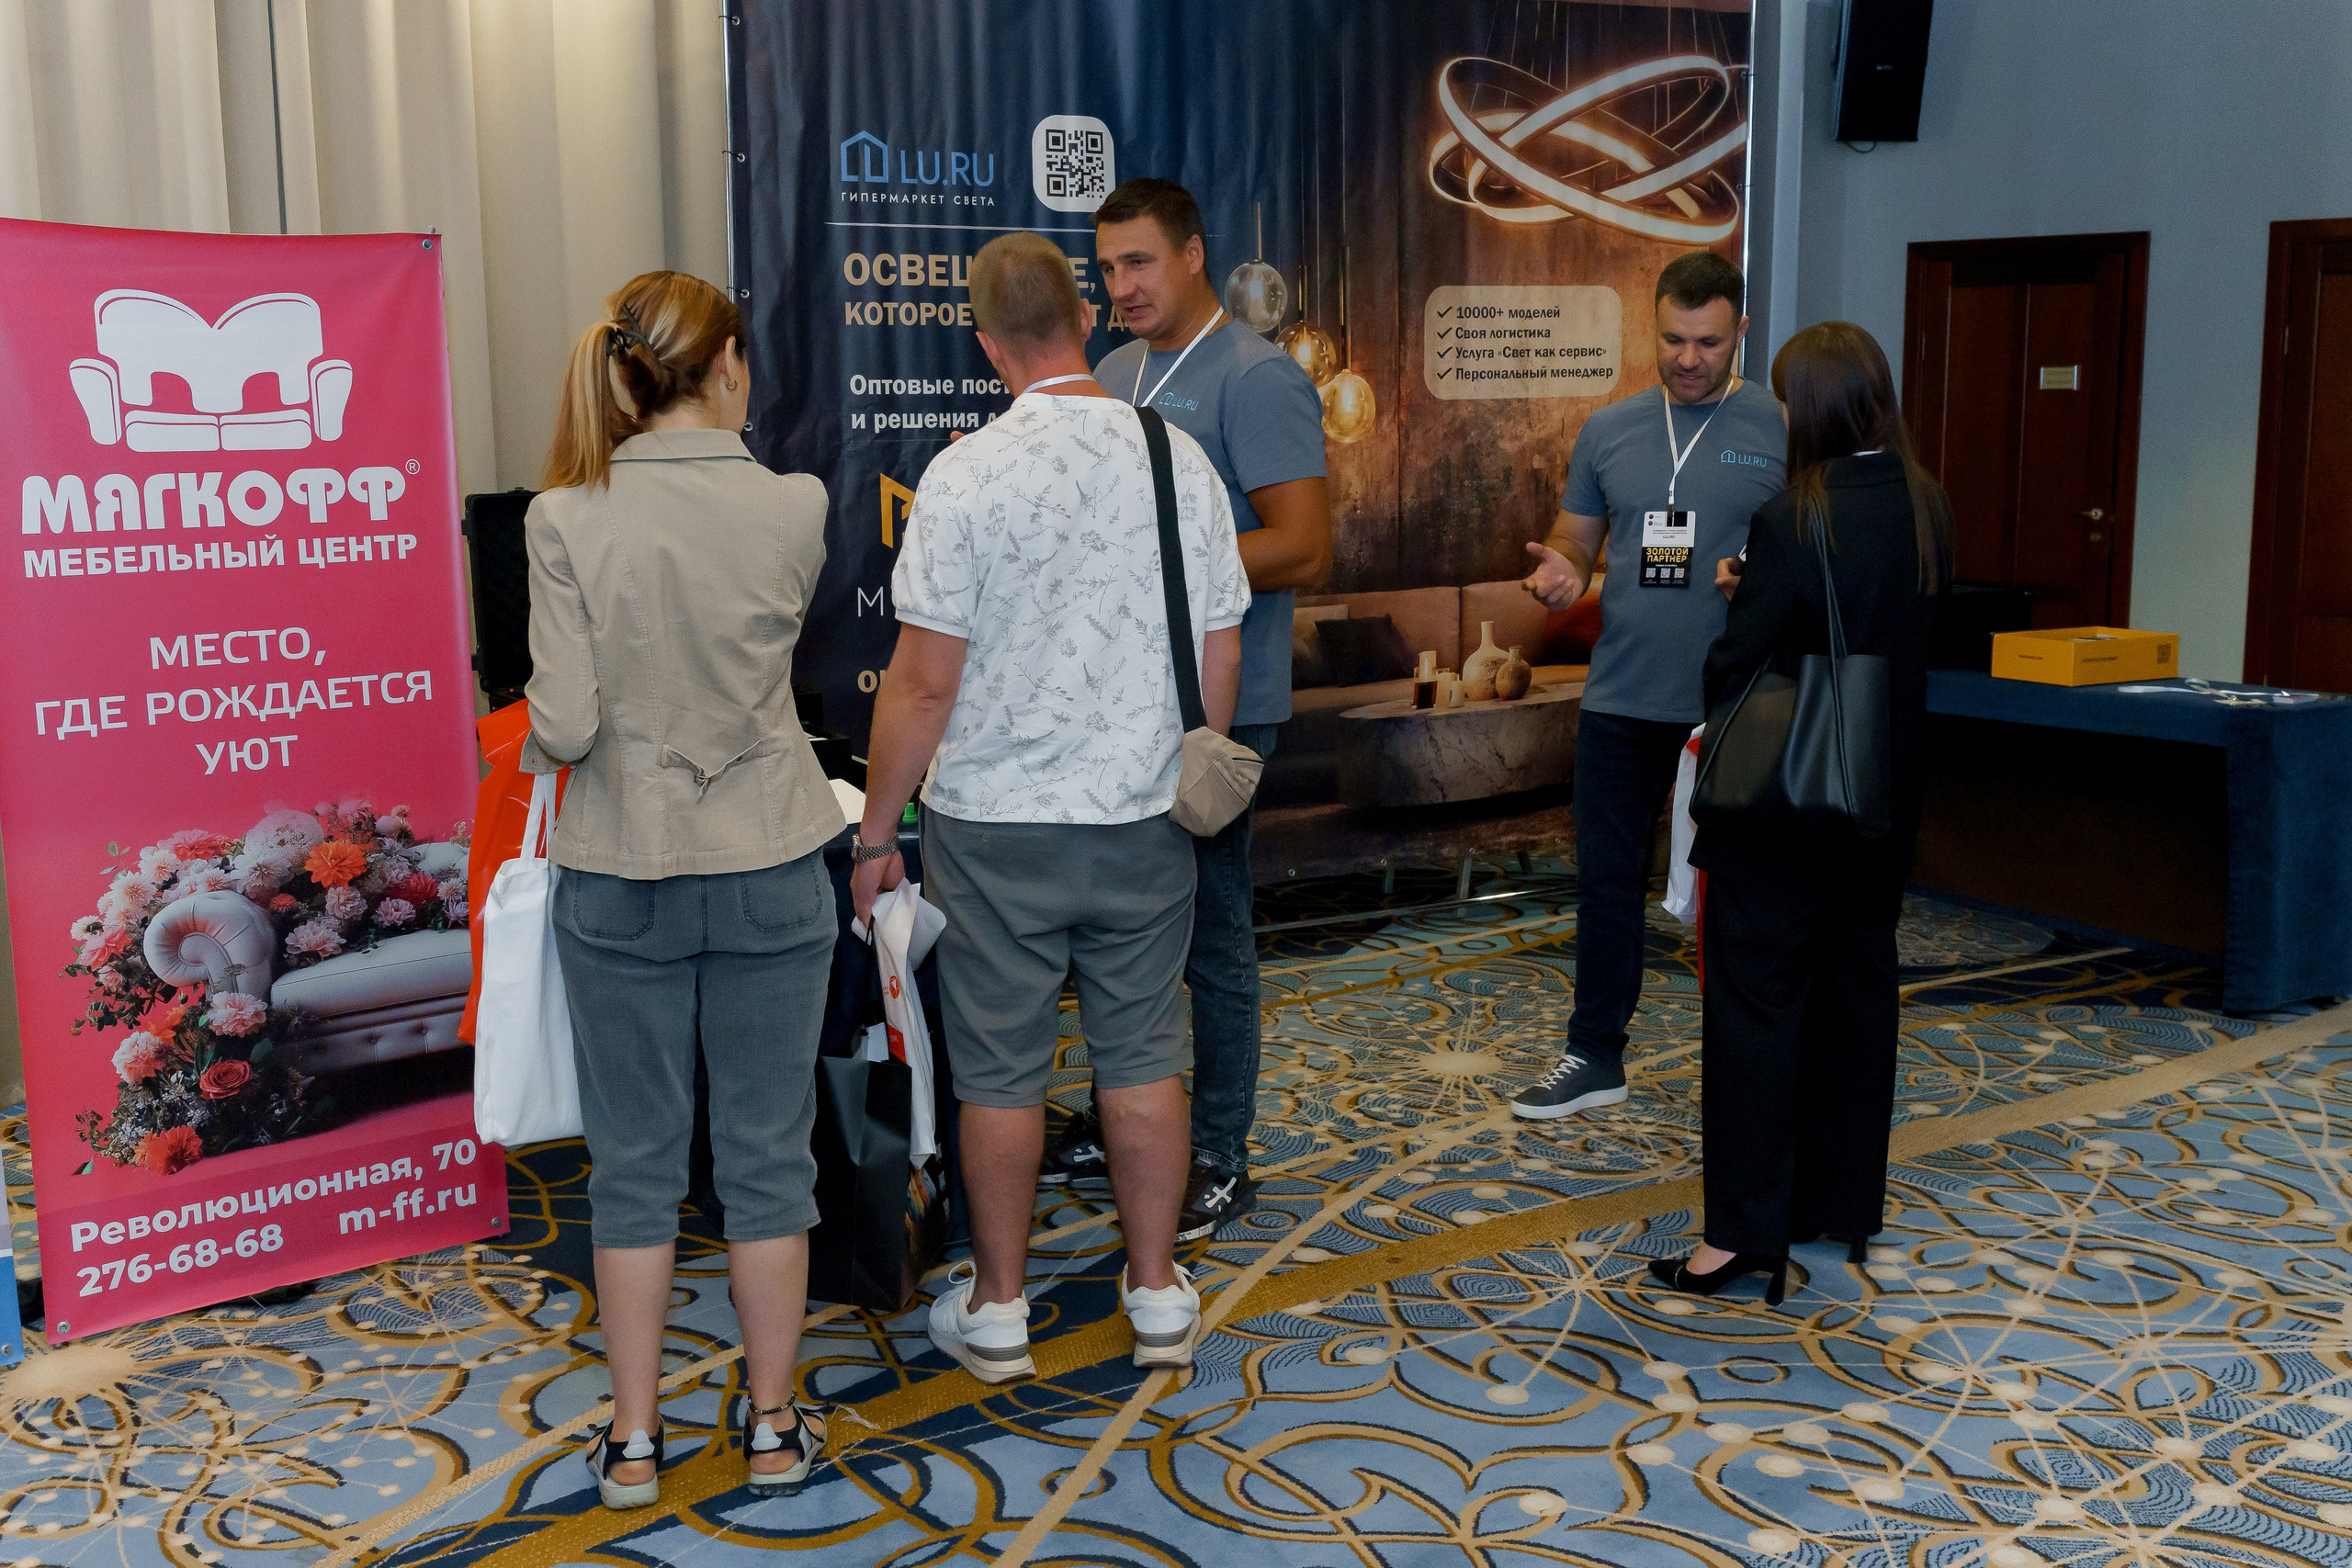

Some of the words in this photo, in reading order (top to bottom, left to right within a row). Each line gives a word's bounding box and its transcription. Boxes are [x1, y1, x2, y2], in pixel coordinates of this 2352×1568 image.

[900, 150, 994, 186] LU.RU
[841, 192, 944, 205] ГИПЕРМАРКЕТ
[953, 195, 995, 206] СВЕТА
[844, 301, 973, 326] КОТОРОЕ
[1456, 306, 1504, 319] 10000+
[1509, 306, 1560, 320] моделей
[1455, 327, 1487, 339] Своя
[1489, 328, 1551, 339] логистика
[1455, 346, 1494, 361] Услуга
[1535, 348, 1555, 357] как
[1456, 366, 1547, 382] Персональный
[1551, 367, 1613, 379] менеджер
[850, 375, 955, 395] Оптовые
[1172, 397, 1199, 411] LU.RU
[852, 413, 865, 429] и
[875, 412, 979, 433] решения
[1738, 454, 1768, 468] LU.RU
[22, 467, 406, 535] МЯГКОФФ
[24, 534, 285, 578] МЕБЕЛЬНЫЙ
[299, 534, 418, 570] ЦЕНТР
[1645, 547, 1689, 556] ЗОЛОТОЙ
[1646, 555, 1688, 563] ПАРТНЕР
[150, 626, 327, 670] МЕСТО,
[35, 695, 128, 740] ГДЕ
[146, 670, 433, 726] РОЖДАЕТСЯ
[195, 735, 299, 775] УЮТ
[70, 1157, 424, 1252] Революционная,
[432, 1138, 477, 1172] 70
[338, 1180, 478, 1235] m-ff.ru
[75, 1224, 284, 1297] 276-68-68
